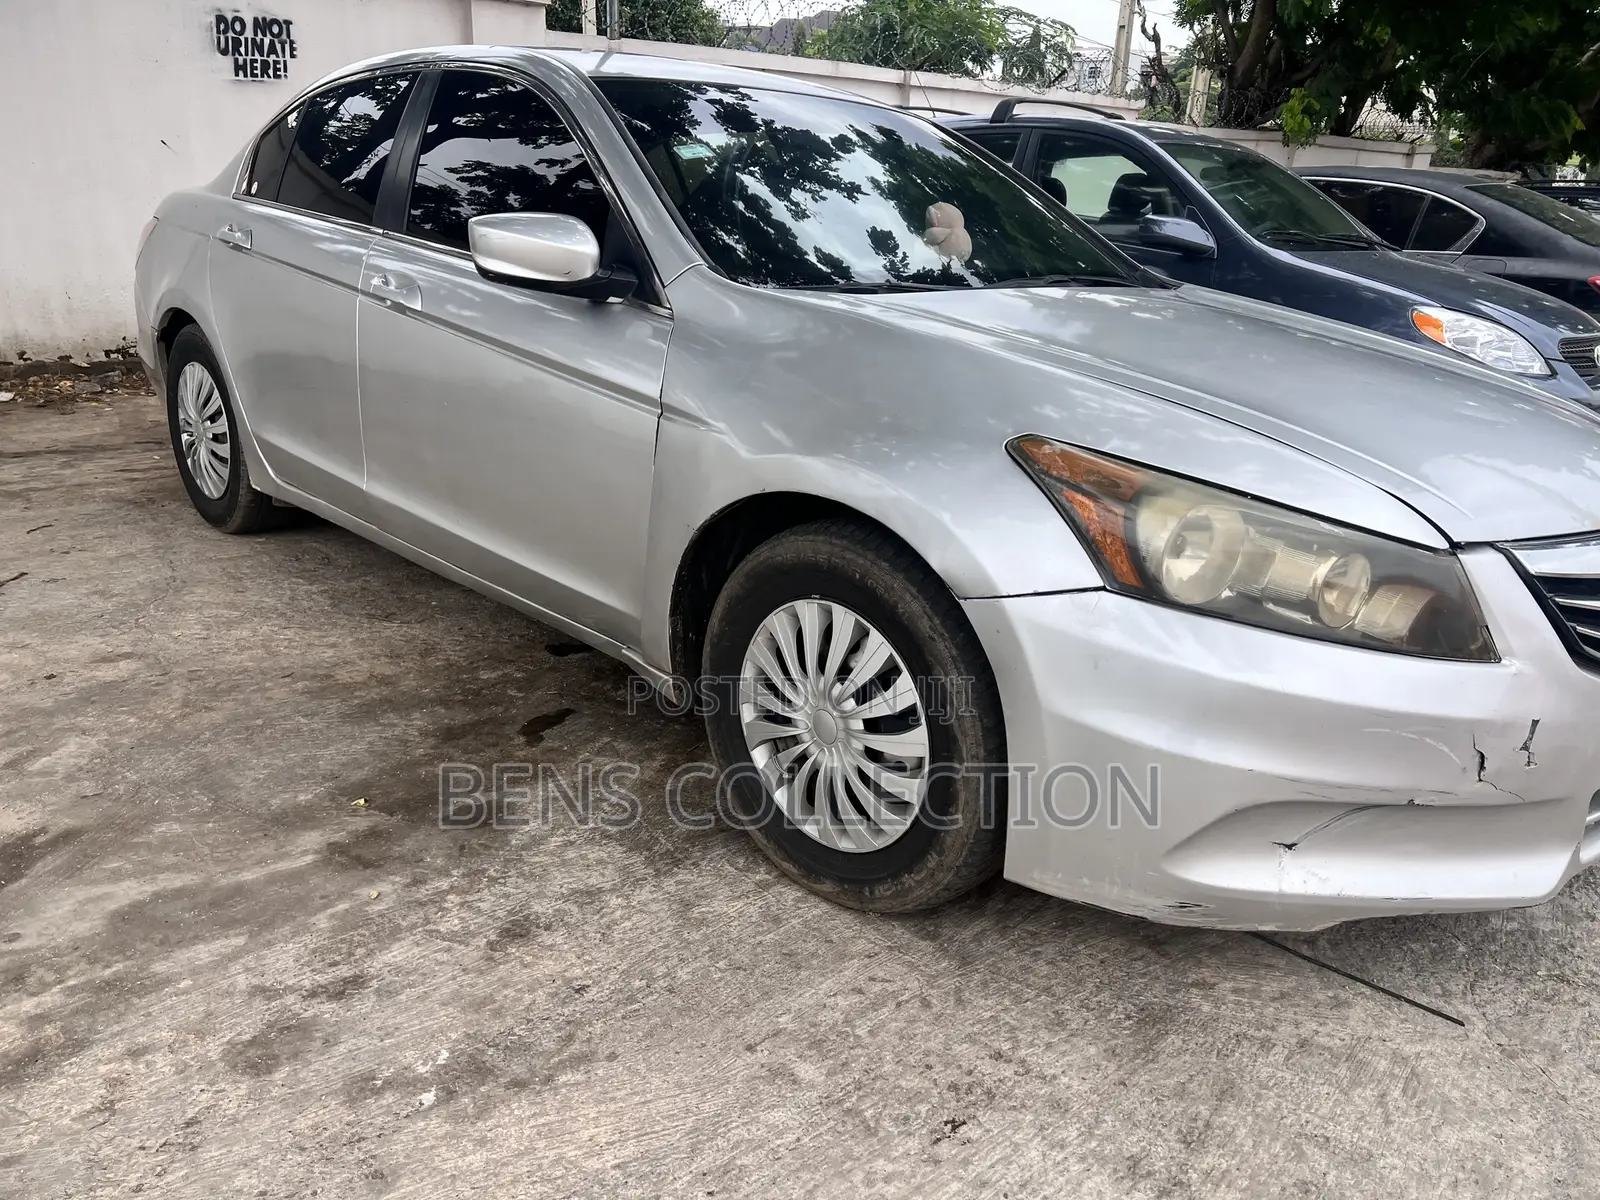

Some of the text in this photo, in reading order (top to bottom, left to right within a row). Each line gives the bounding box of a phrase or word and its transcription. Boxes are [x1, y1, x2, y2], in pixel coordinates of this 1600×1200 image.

[215, 14, 293, 39] DO NOT
[216, 36, 297, 58] URINATE
[233, 57, 288, 79] HERE!
